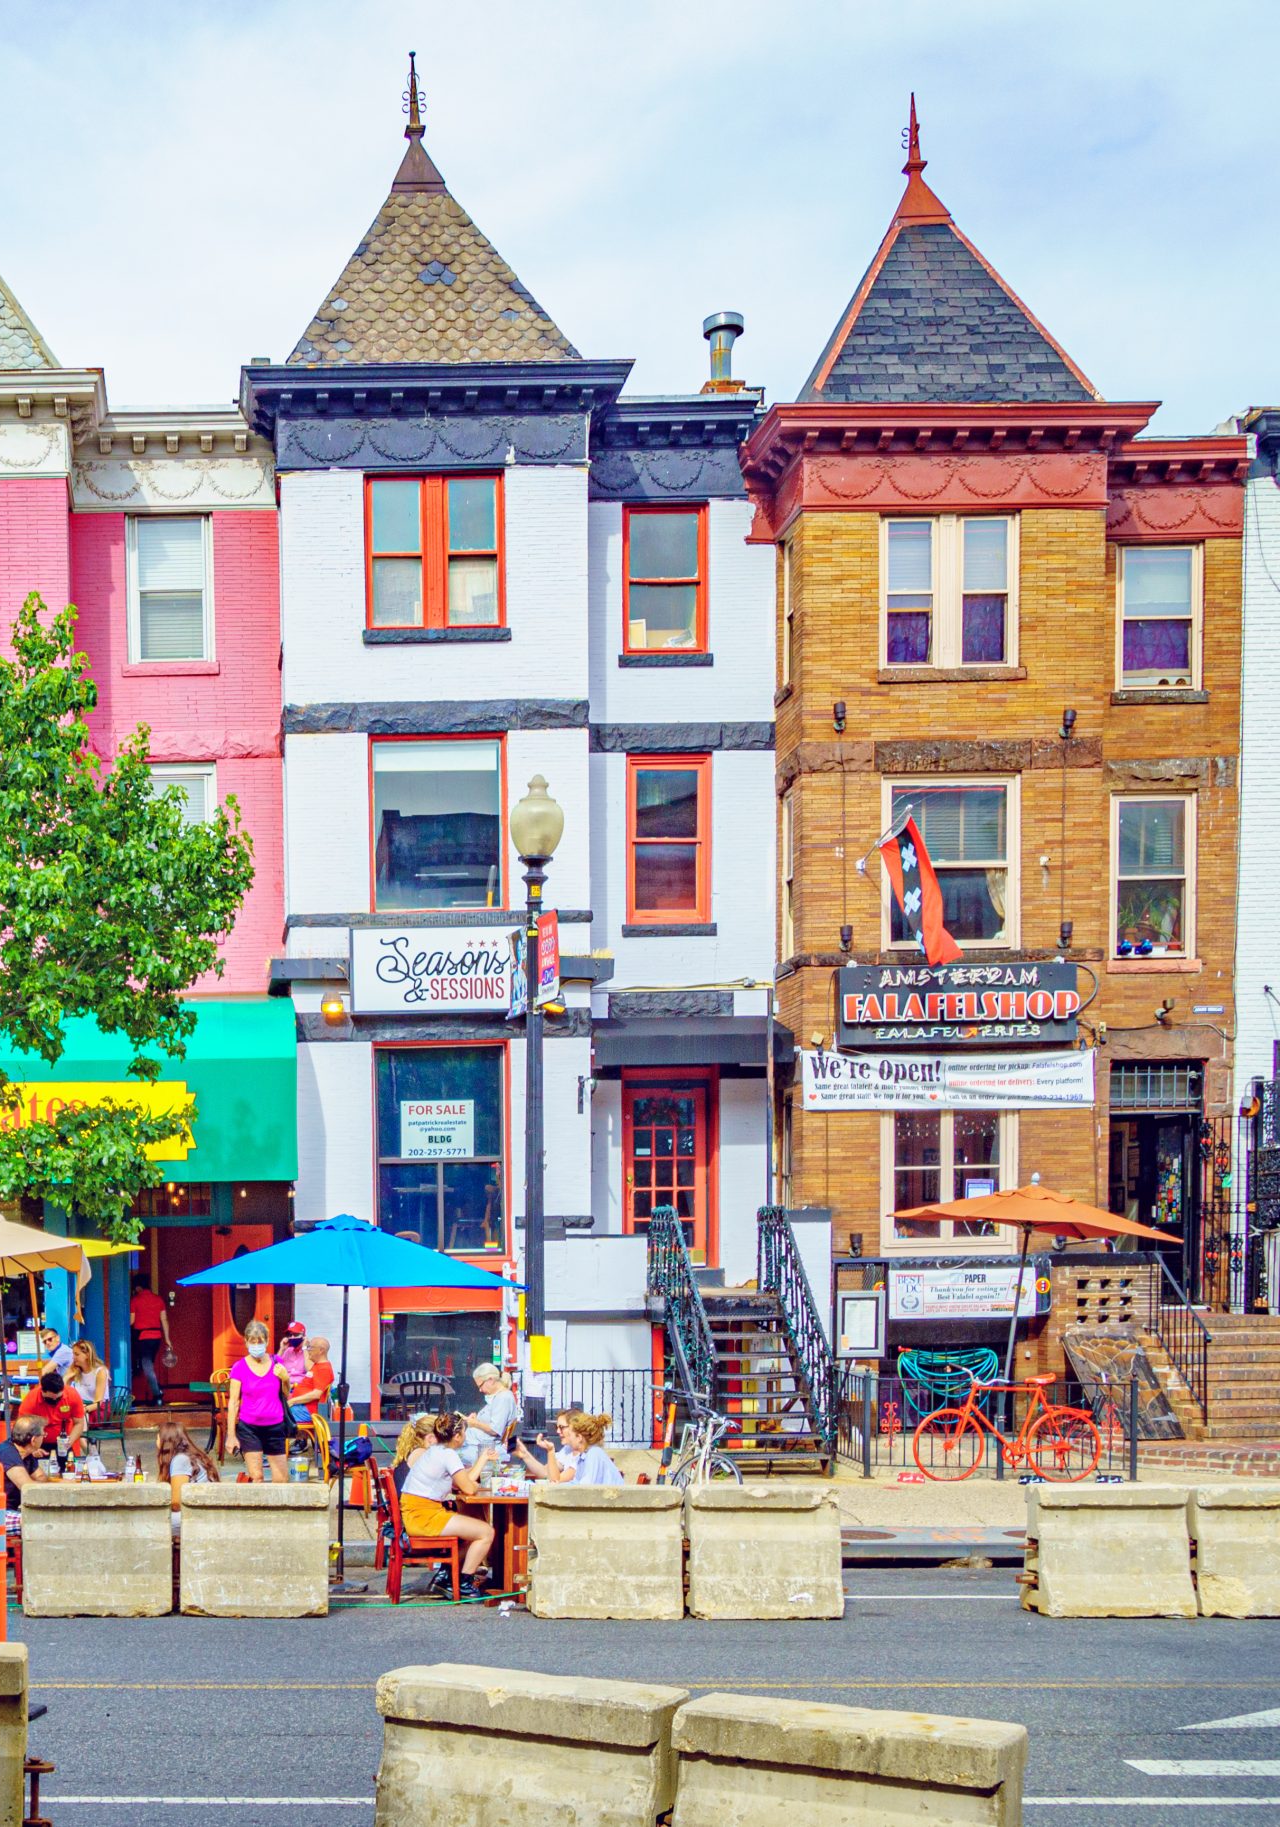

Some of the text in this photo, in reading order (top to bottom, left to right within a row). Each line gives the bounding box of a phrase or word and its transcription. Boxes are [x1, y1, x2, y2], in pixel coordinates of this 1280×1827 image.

[376, 937, 510, 983] Seasons
[879, 966, 1041, 988] AMSTERDAM
[404, 976, 505, 1003] & SESSIONS
[844, 989, 1080, 1023] FALAFELSHOP
[810, 1056, 941, 1083] We're Open!
[969, 1063, 996, 1072] ordering
[1008, 1062, 1030, 1071] pickup:
[1031, 1061, 1083, 1069] Falafelshop.com
[969, 1079, 996, 1087] ordering
[1008, 1078, 1035, 1086] delivery:
[1036, 1078, 1054, 1086] Every
[1055, 1077, 1084, 1085] platform!
[839, 1093, 855, 1101] great
[912, 1093, 926, 1101] you!
[408, 1104, 466, 1115] FOR SALE
[428, 1135, 452, 1143] BLDG
[408, 1148, 467, 1156] 202-257-5771
[964, 1274, 986, 1283] PAPER
[965, 1285, 975, 1294] for
